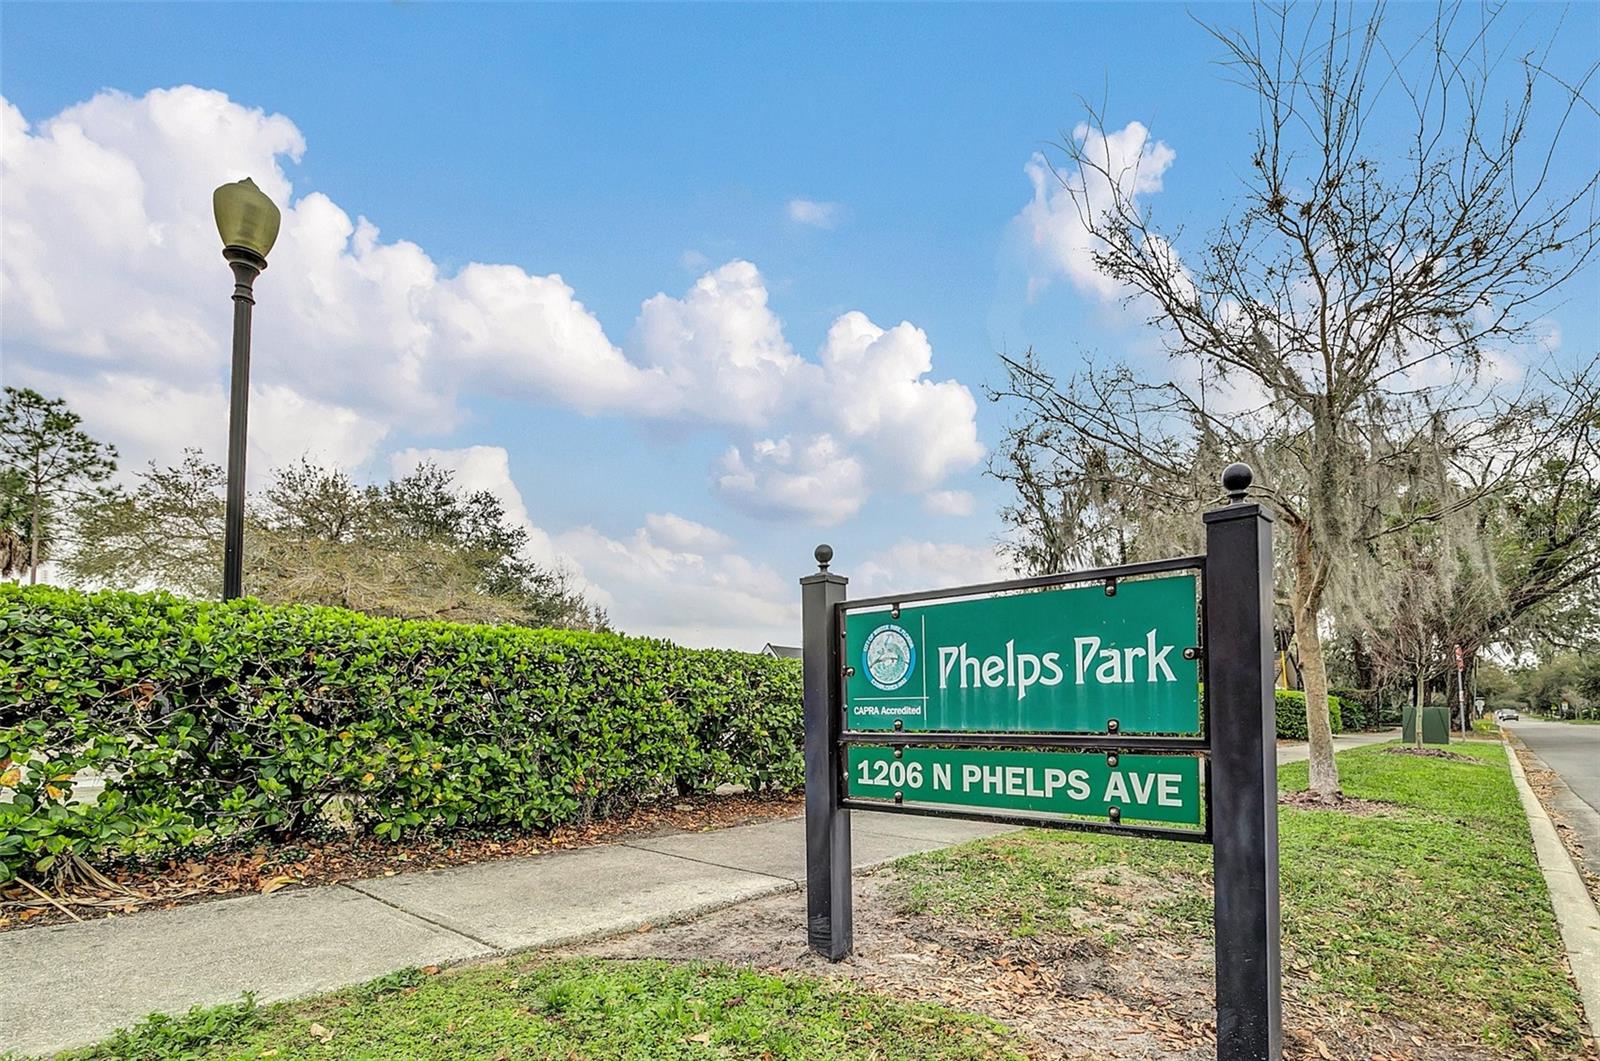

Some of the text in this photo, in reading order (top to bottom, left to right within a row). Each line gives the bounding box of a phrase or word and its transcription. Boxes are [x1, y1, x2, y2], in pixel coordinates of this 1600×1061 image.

[938, 628, 1178, 701] Phelps Park
[853, 705, 922, 715] CAPRA Accredited
[857, 759, 1183, 807] 1206 N PHELPS AVE
